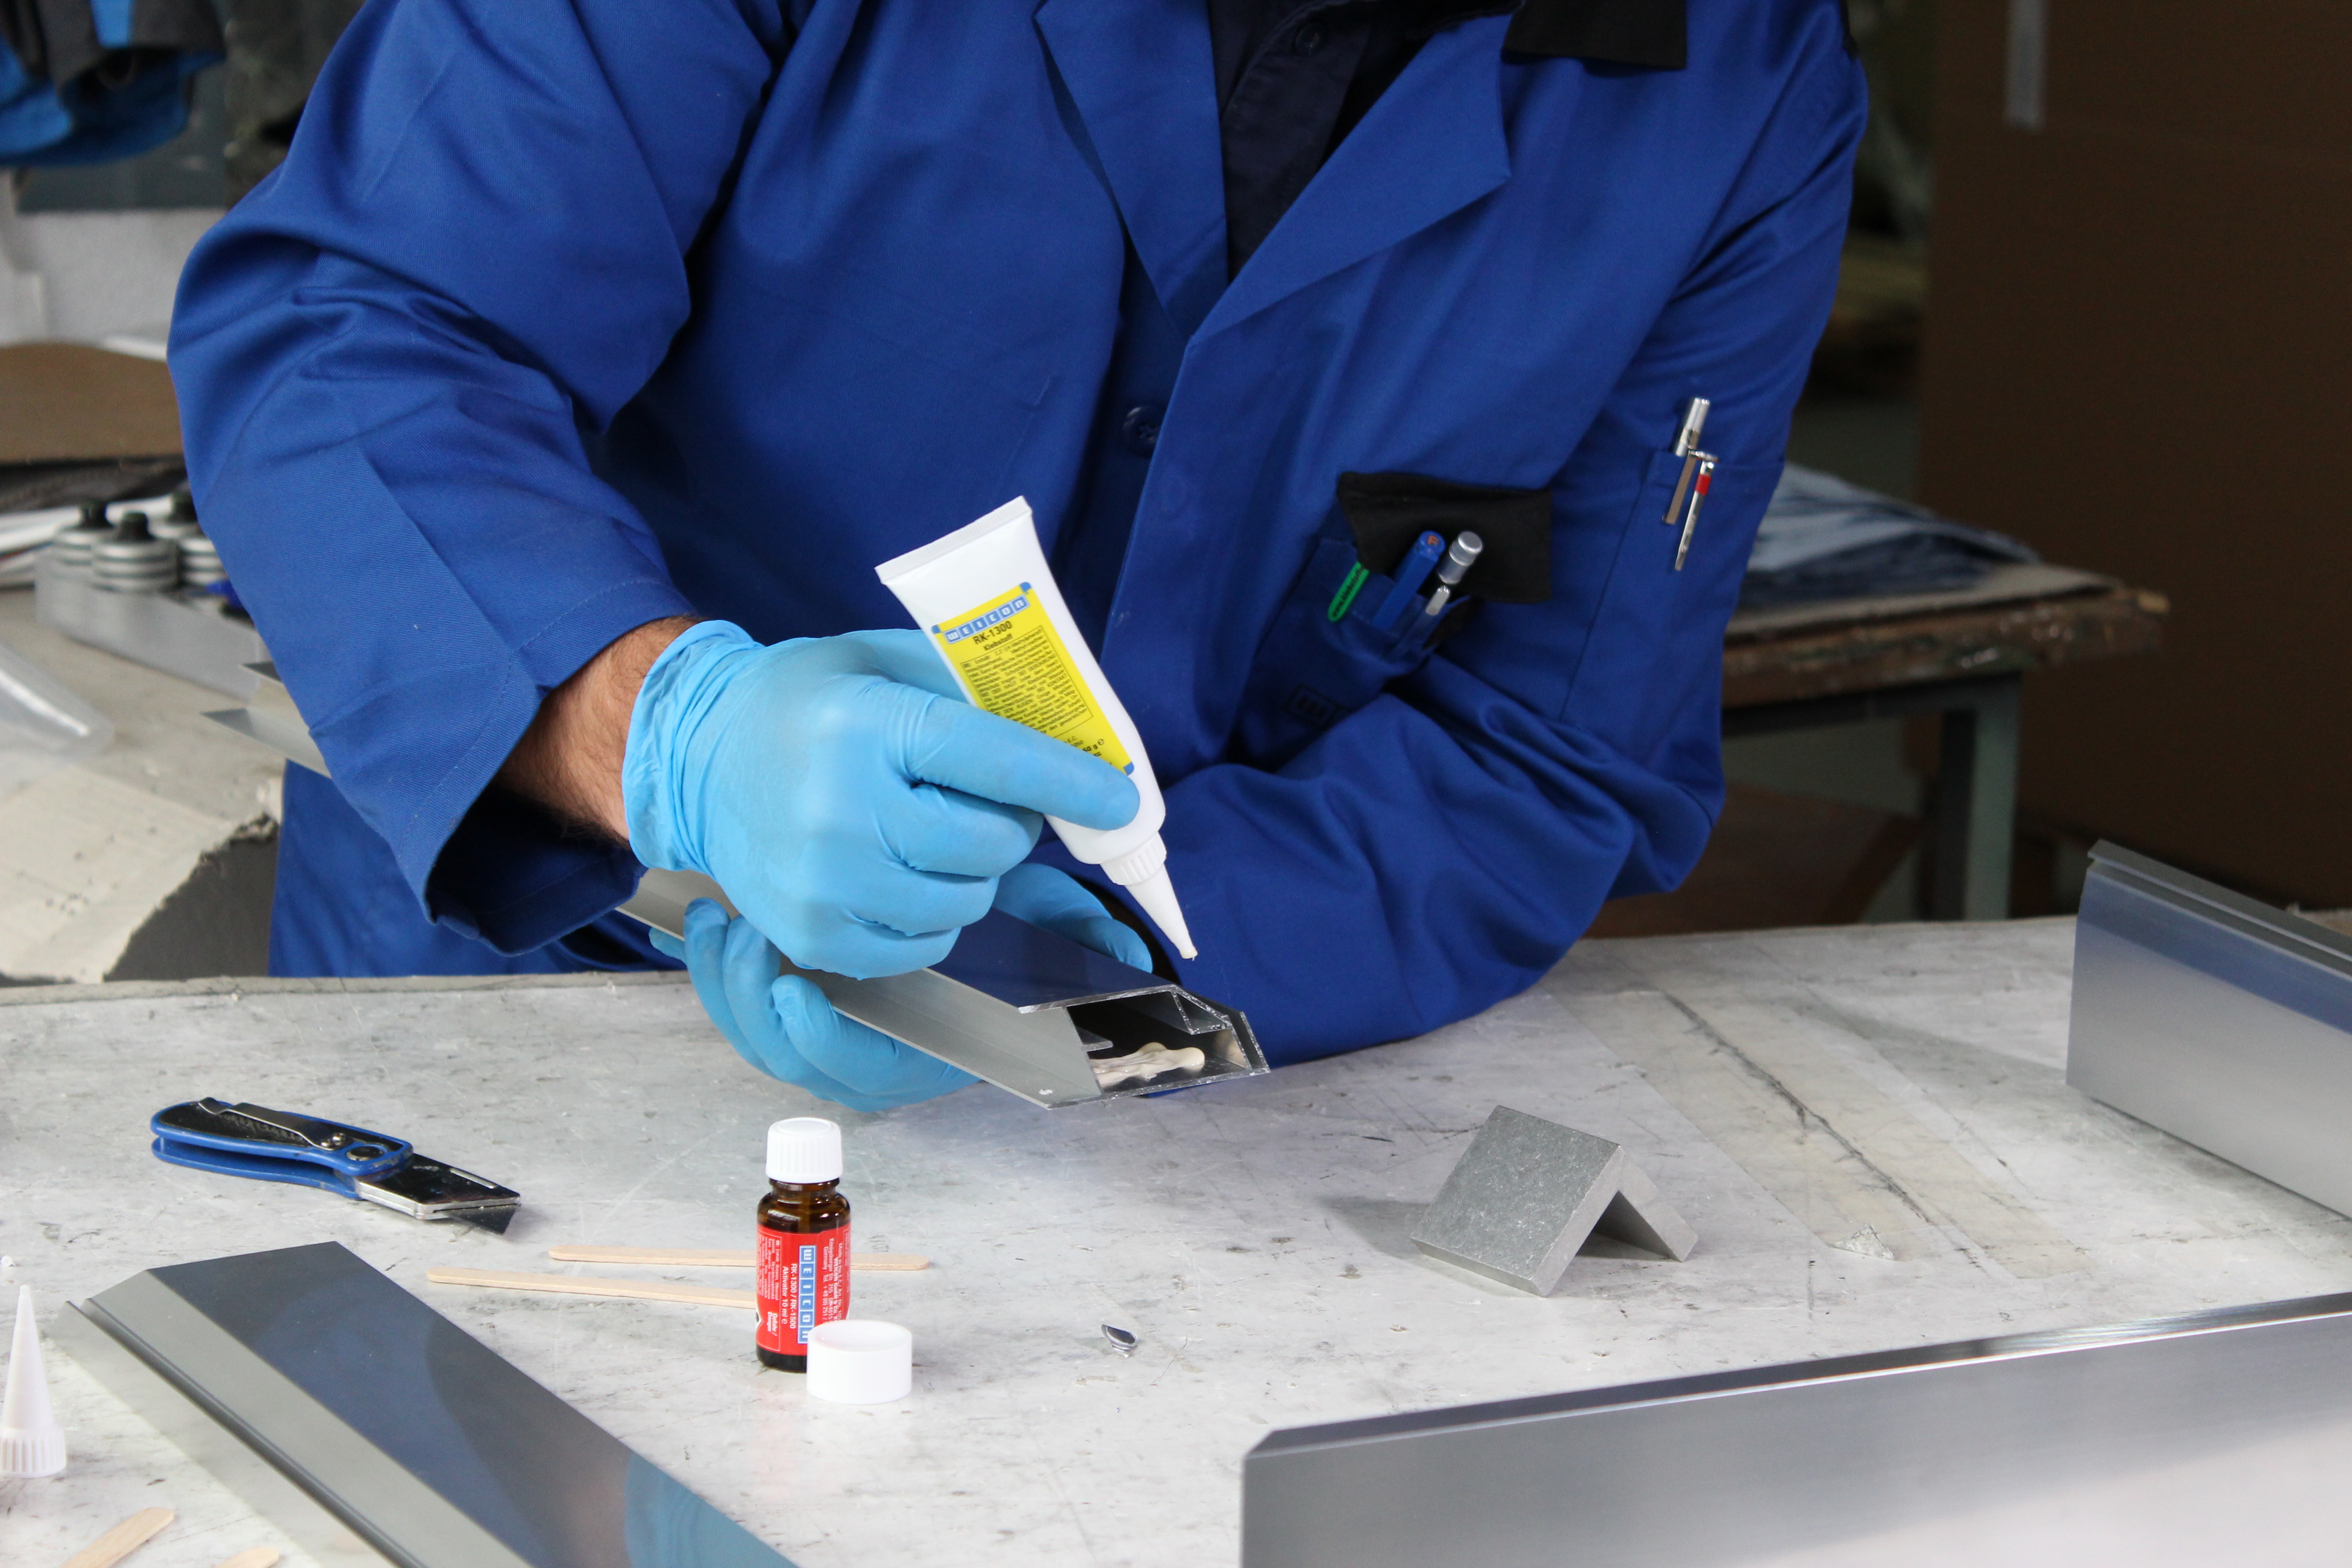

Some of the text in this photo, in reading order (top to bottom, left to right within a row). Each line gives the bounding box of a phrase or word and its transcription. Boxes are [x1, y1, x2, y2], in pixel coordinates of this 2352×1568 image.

[972, 620, 1013, 645] RK-1300
[984, 634, 1012, 650] Klebstoff
[782, 1299, 788, 1307] 10
[782, 1308, 787, 1317] ml
